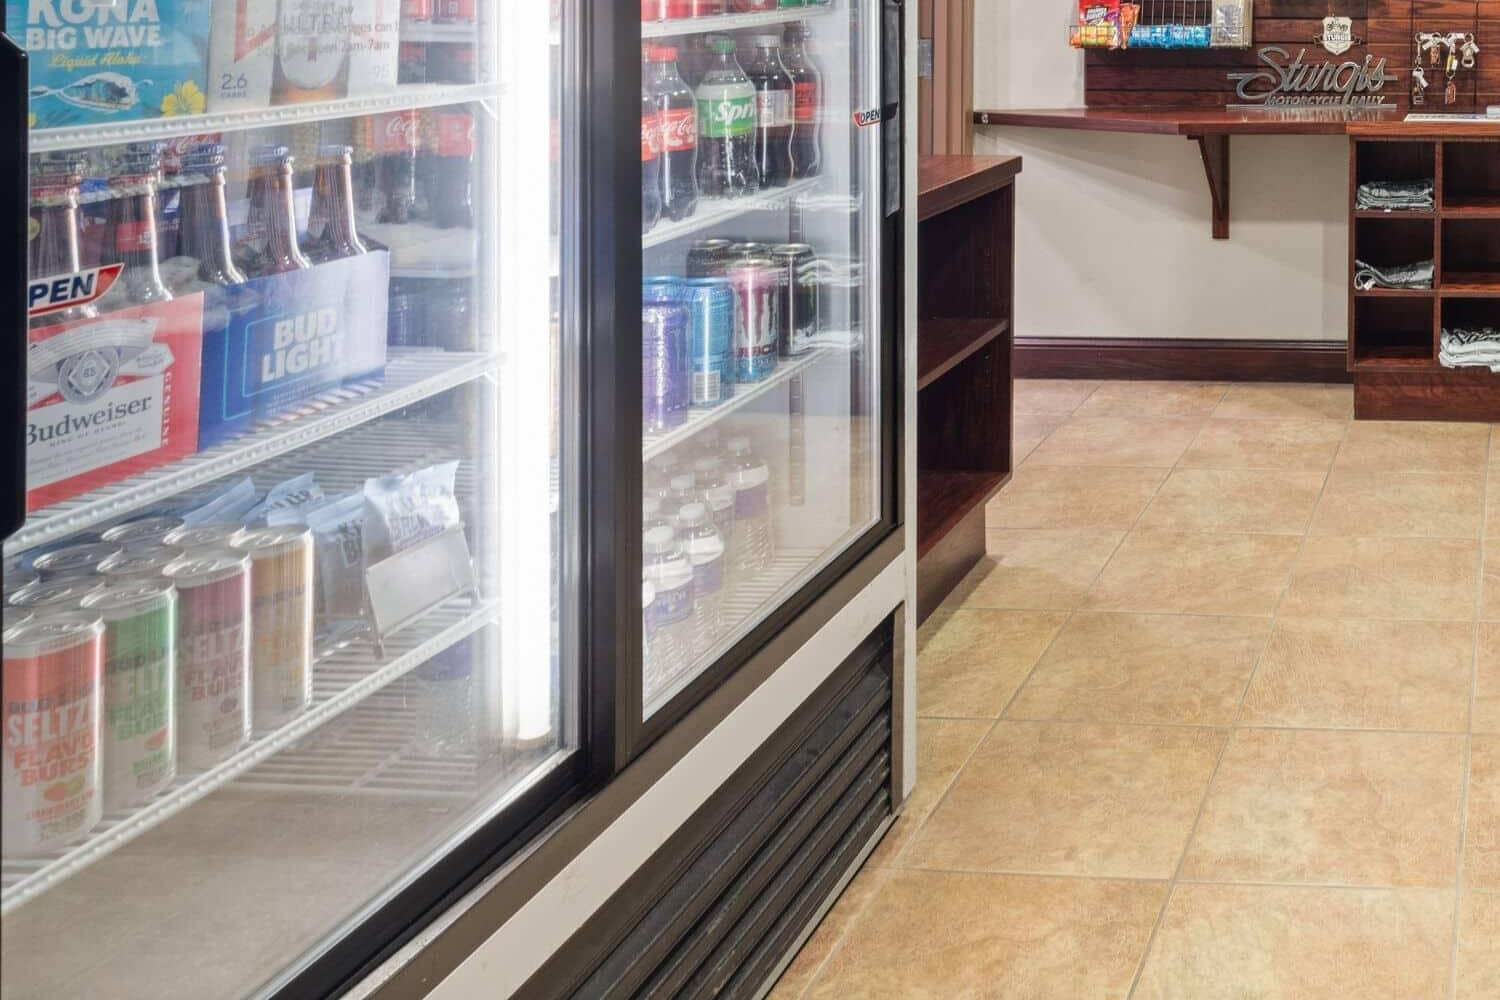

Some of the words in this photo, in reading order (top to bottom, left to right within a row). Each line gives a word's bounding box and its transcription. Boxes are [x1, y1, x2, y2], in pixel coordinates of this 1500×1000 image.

[26, 27, 78, 51] BIG
[83, 25, 161, 49] WAVE
[220, 73, 249, 91] 2.6
[1227, 46, 1398, 102] Sturgis
[860, 110, 881, 124] OPEN
[1264, 95, 1344, 106] MOTORCYCLE
[1350, 95, 1386, 106] RALLY
[29, 273, 94, 308] PEN
[274, 307, 338, 350] BUD
[260, 339, 345, 383] LIGHT
[26, 397, 153, 446] Budweiser
[163, 371, 172, 445] GENUINE
